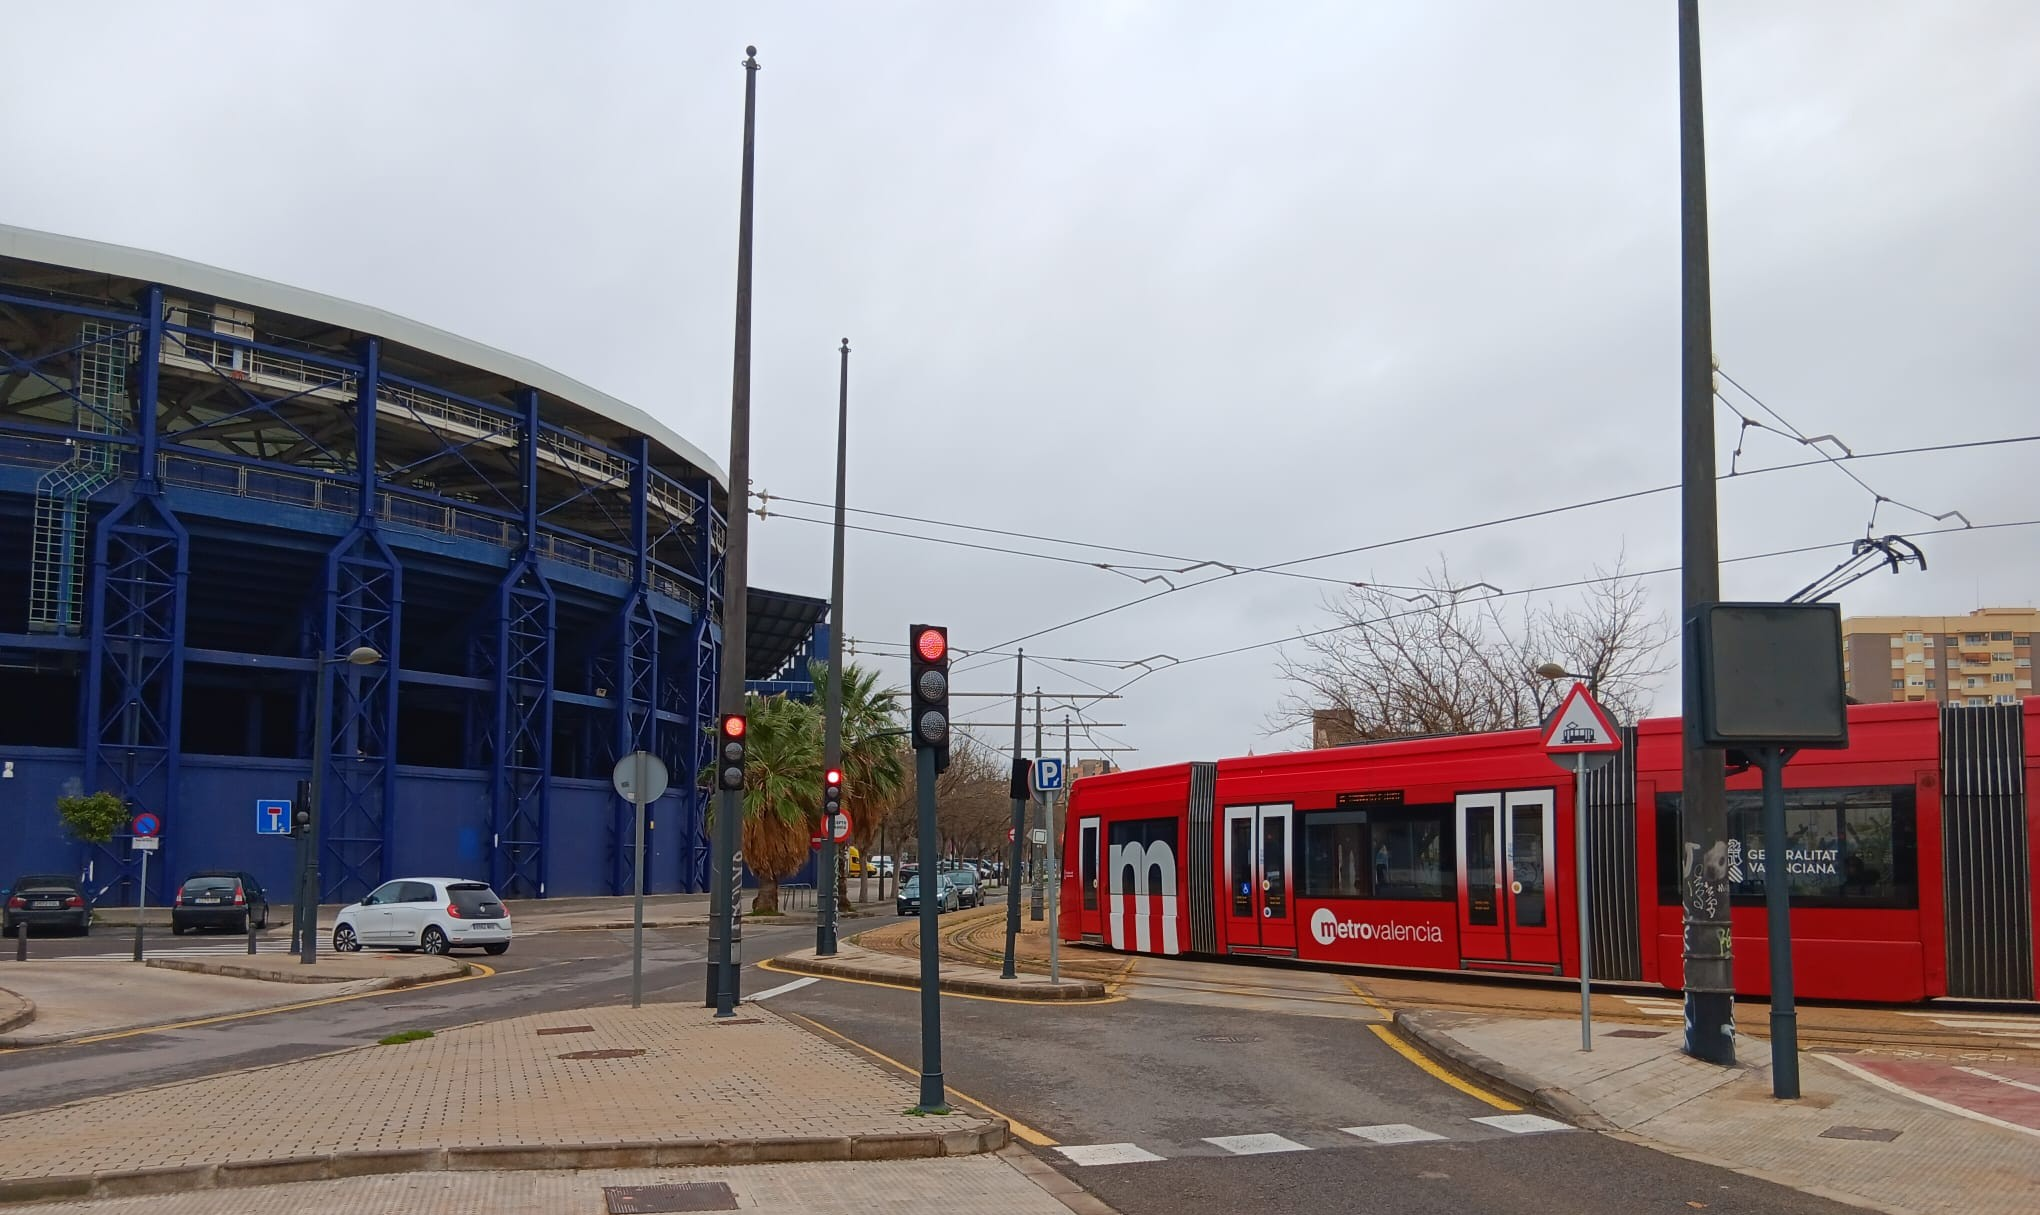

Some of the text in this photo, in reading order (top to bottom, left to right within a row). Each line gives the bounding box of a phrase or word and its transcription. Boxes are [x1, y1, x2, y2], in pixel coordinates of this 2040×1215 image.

[1042, 761, 1058, 786] P
[1747, 849, 1838, 861] GERALITAT
[1748, 862, 1836, 874] VACIANA
[1109, 840, 1179, 955] m
[1320, 919, 1443, 943] metrovalencia
